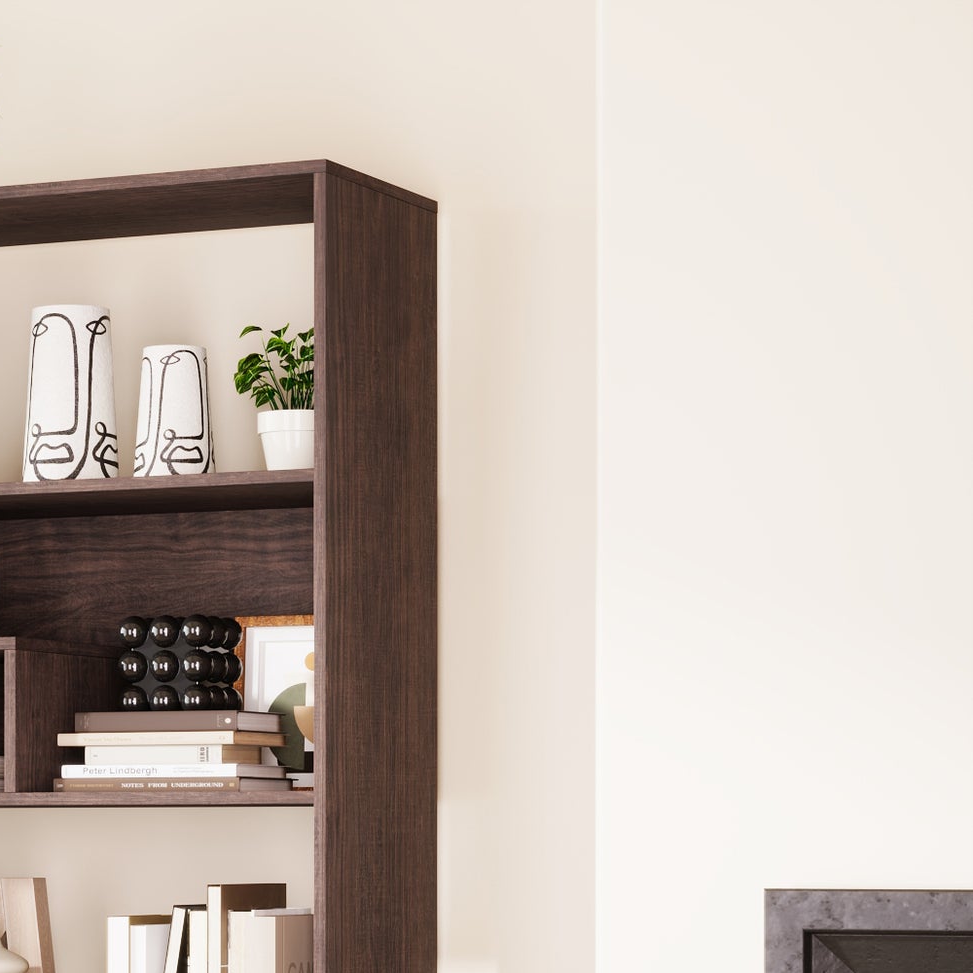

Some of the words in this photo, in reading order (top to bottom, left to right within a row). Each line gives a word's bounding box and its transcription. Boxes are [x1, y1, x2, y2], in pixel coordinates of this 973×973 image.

[82, 767, 107, 775] Peter
[109, 766, 158, 776] Lindbergh
[121, 781, 144, 789] NOTES
[147, 781, 168, 789] FROM
[170, 781, 224, 789] UNDERGROUND
